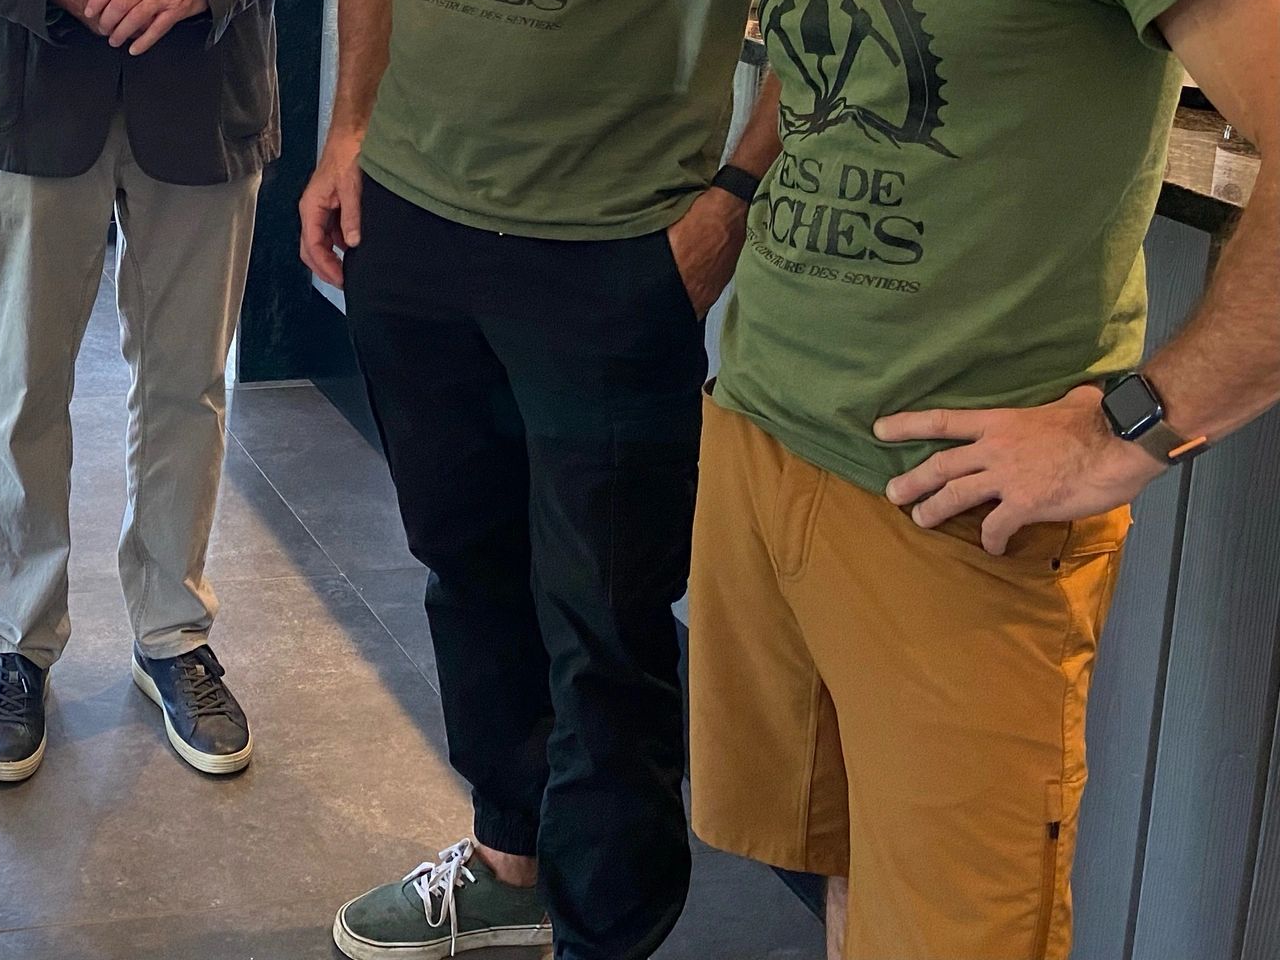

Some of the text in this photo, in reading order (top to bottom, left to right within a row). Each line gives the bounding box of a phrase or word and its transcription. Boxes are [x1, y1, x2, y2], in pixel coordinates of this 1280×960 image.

[480, 9, 503, 21] DES
[506, 15, 562, 31] SENTIERS
[837, 163, 905, 206] DE
[808, 265, 839, 280] DES
[841, 271, 921, 293] SENTIERS
